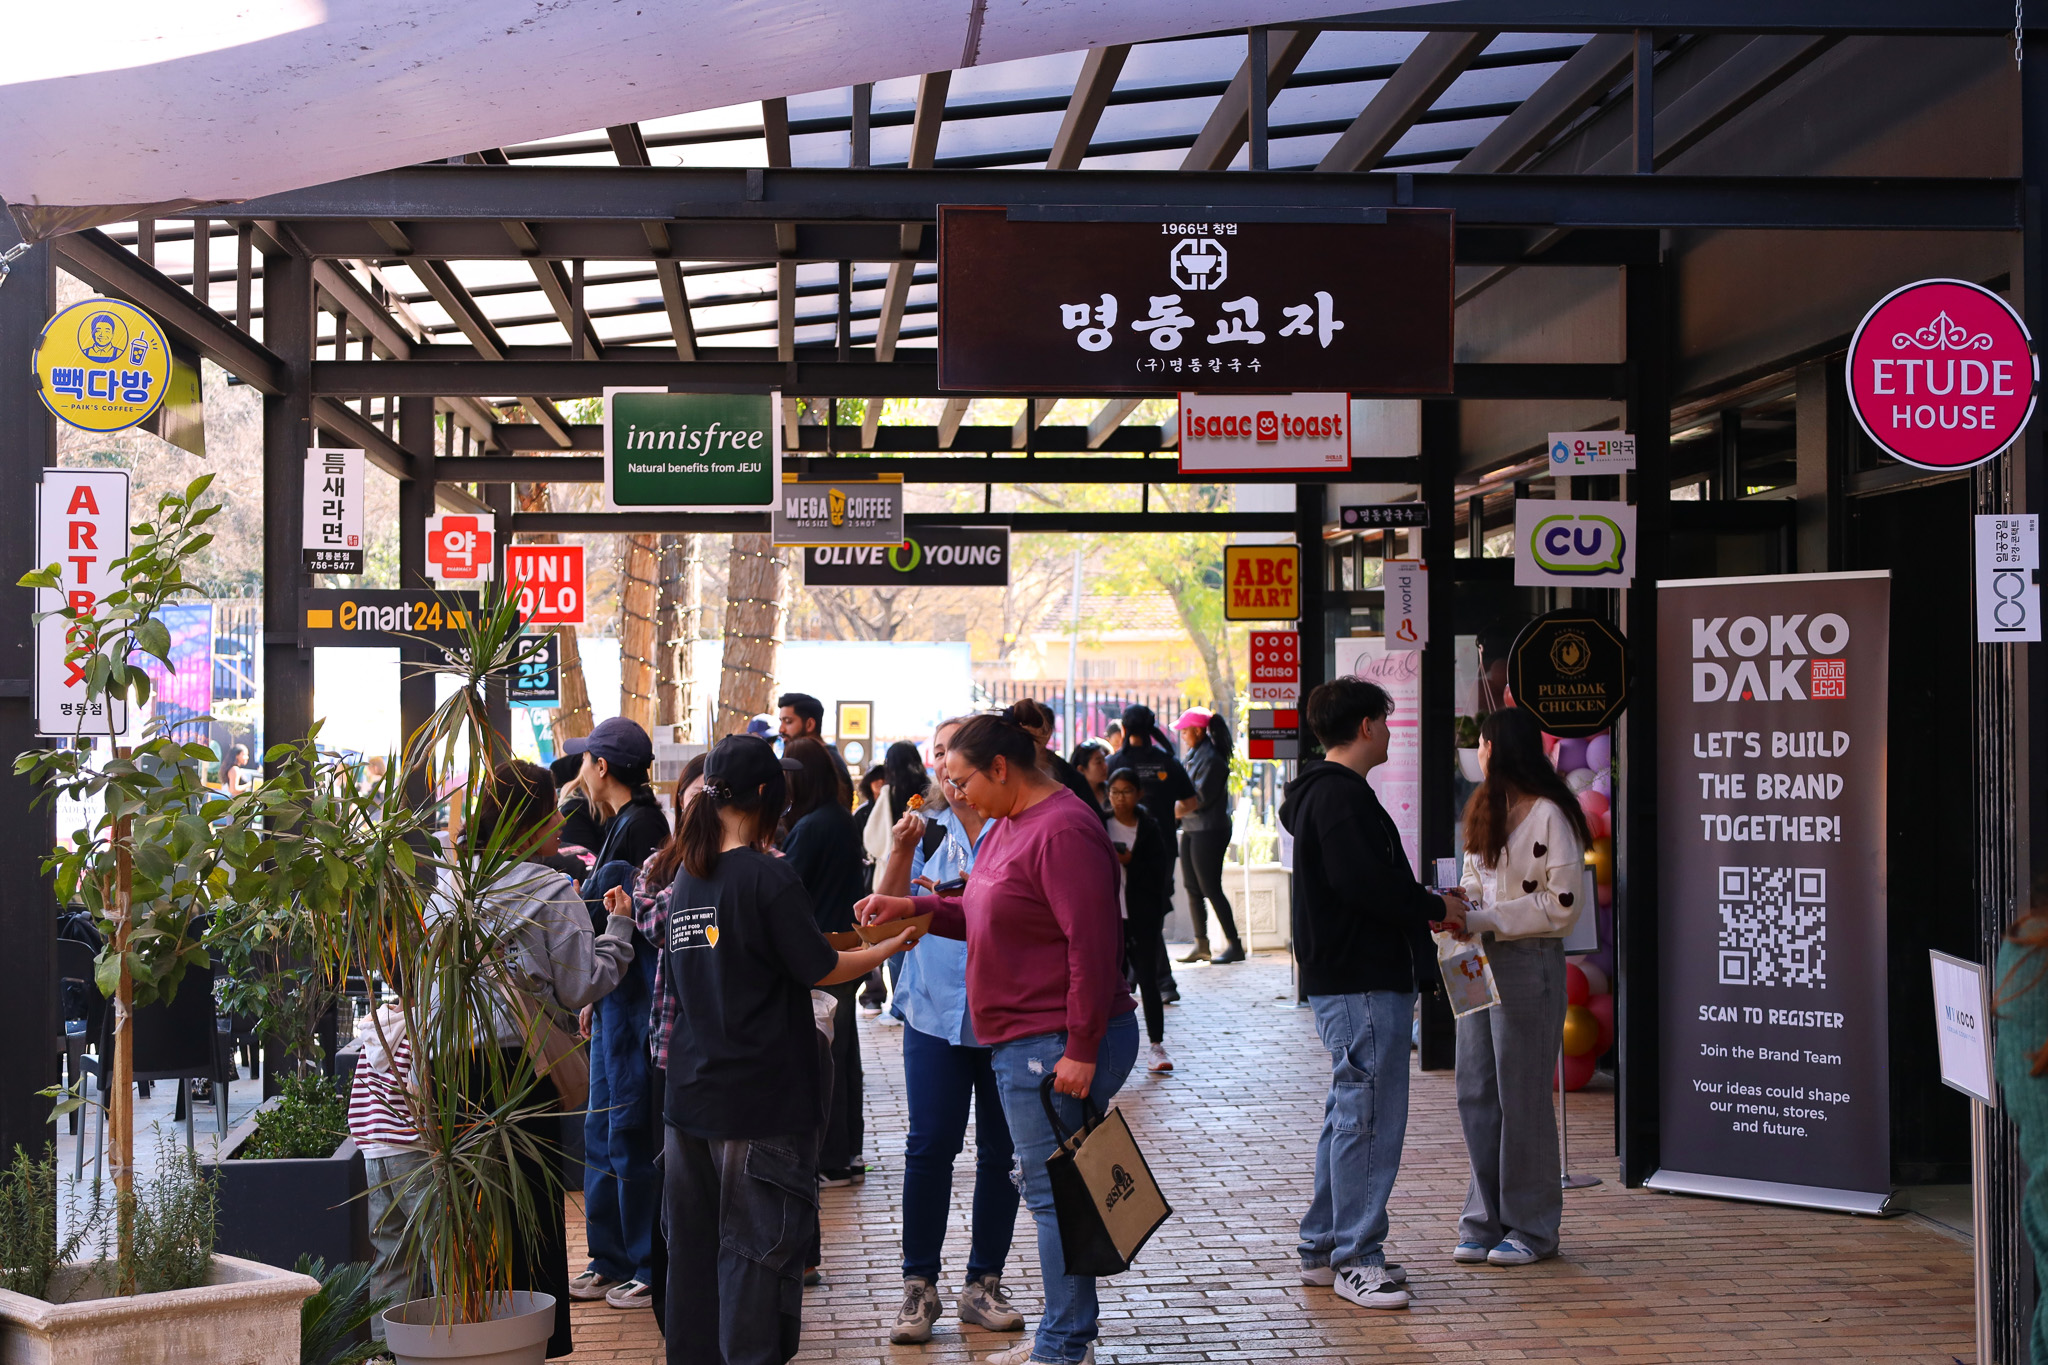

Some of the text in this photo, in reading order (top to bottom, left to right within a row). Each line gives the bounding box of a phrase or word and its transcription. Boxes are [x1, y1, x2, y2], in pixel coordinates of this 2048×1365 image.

[1160, 223, 1238, 235] 1966년 창업
[1059, 290, 1345, 352] 명동교자
[52, 367, 153, 403] 빽다방
[1872, 359, 2015, 396] ETUDE
[1186, 408, 1343, 437] isaac toast
[1892, 405, 1996, 430] HOUSE
[626, 422, 764, 457] innisfree
[628, 462, 762, 473] Natural benefits from JEJU
[322, 453, 346, 544] 틈새라면
[786, 498, 892, 519] MEGA COFFEE
[443, 531, 477, 566] 약
[1544, 526, 1602, 556] CU
[310, 562, 355, 570] 756-5477
[814, 545, 1001, 565] OLIVE YOUNG
[515, 555, 571, 582] UNI
[1233, 558, 1293, 586] ABC
[515, 586, 577, 618] QLO
[1233, 588, 1293, 607] MART
[1398, 576, 1412, 615] world
[339, 601, 443, 631] emart24
[1692, 613, 1850, 658] KOKO
[519, 640, 549, 664] GS
[518, 663, 550, 688] 25
[1255, 665, 1294, 677] daiso
[1693, 659, 1808, 702] DAK
[1252, 687, 1296, 700] 다이소
[1538, 682, 1606, 696] PURADAK
[60, 703, 103, 716] 명동점
[1538, 699, 1606, 713] CHICKEN
[1693, 730, 1850, 758] LET'S BUILD
[1698, 773, 1844, 801] THE BRAND
[1700, 814, 1841, 842] TOGETHER!
[1699, 1005, 1844, 1029] SCAN TO REGISTER
[1700, 1044, 1842, 1065] Join the Brand Team
[1692, 1079, 1850, 1104] Your ideas could shape
[1709, 1102, 1828, 1122] our menu, stores,
[1732, 1119, 1808, 1138] and future.
